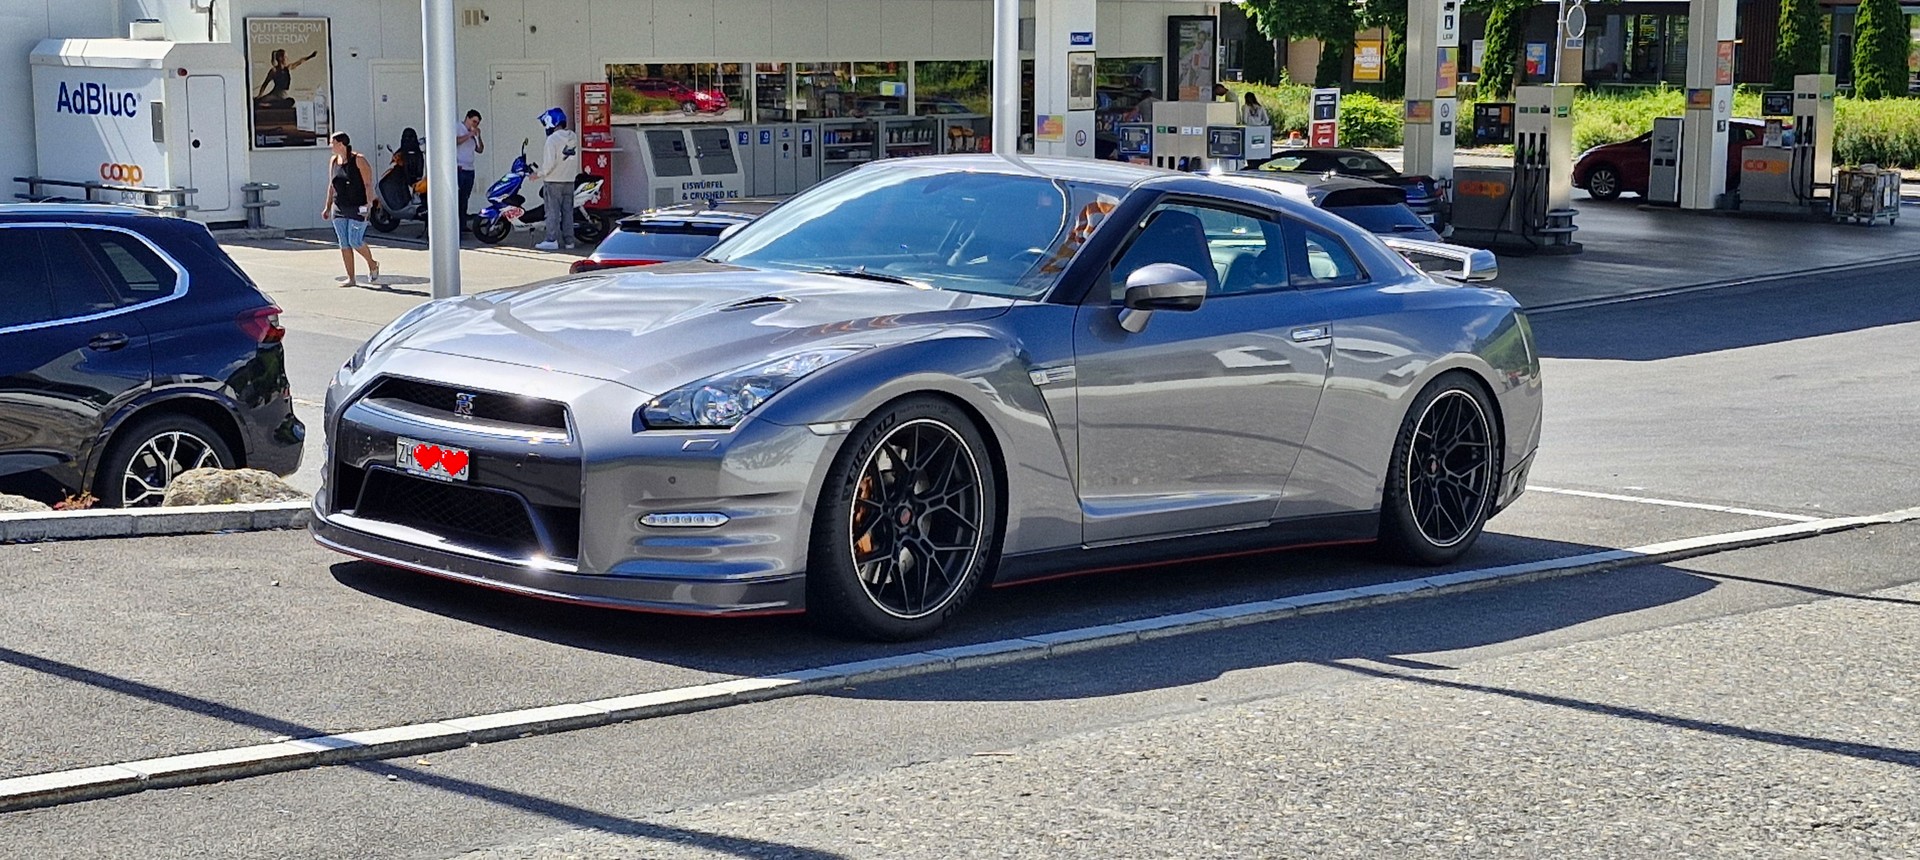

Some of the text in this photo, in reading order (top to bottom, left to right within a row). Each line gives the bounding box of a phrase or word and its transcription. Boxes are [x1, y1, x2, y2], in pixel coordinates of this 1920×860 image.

[250, 22, 321, 33] OUTPERFORM
[251, 33, 310, 44] YESTERDAY
[100, 162, 143, 186] coop
[682, 190, 739, 200] & CRUSHED ICE
[399, 442, 413, 466] ZH
